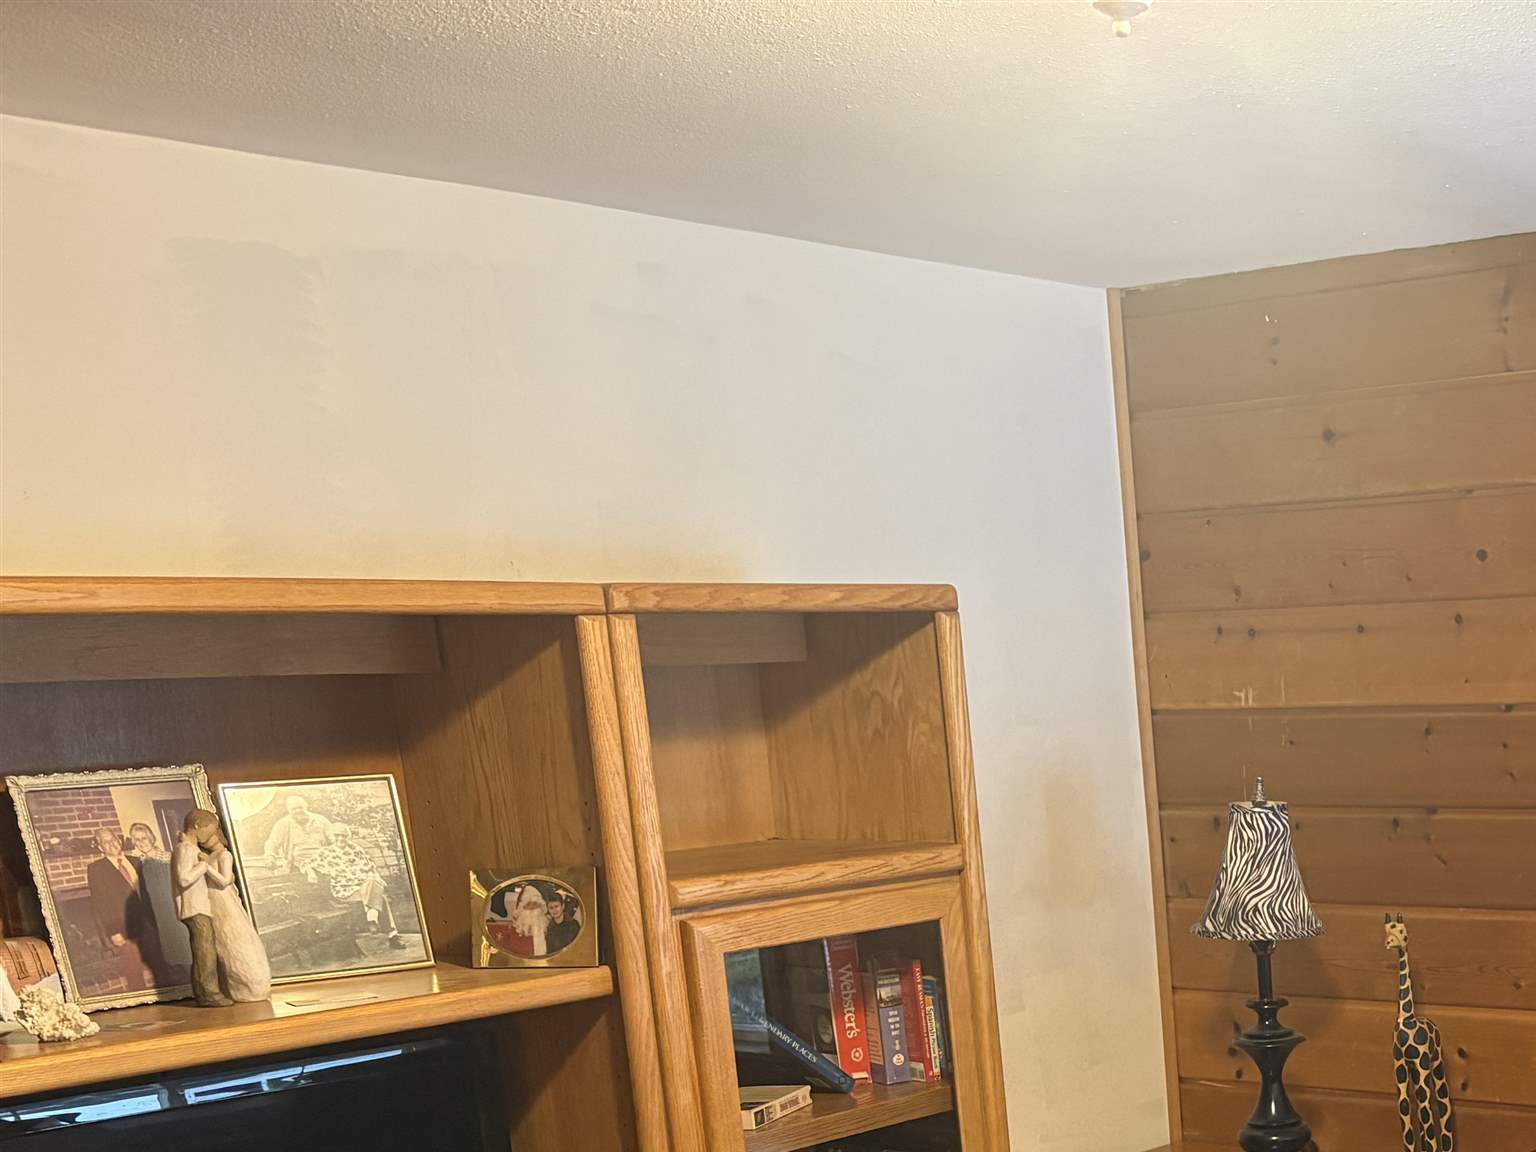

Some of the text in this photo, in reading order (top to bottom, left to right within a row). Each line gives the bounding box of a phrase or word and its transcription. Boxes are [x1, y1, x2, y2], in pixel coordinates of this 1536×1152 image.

[838, 963, 858, 1039] Webster's
[925, 1007, 937, 1036] Spanish
[790, 1040, 818, 1064] PLACES
